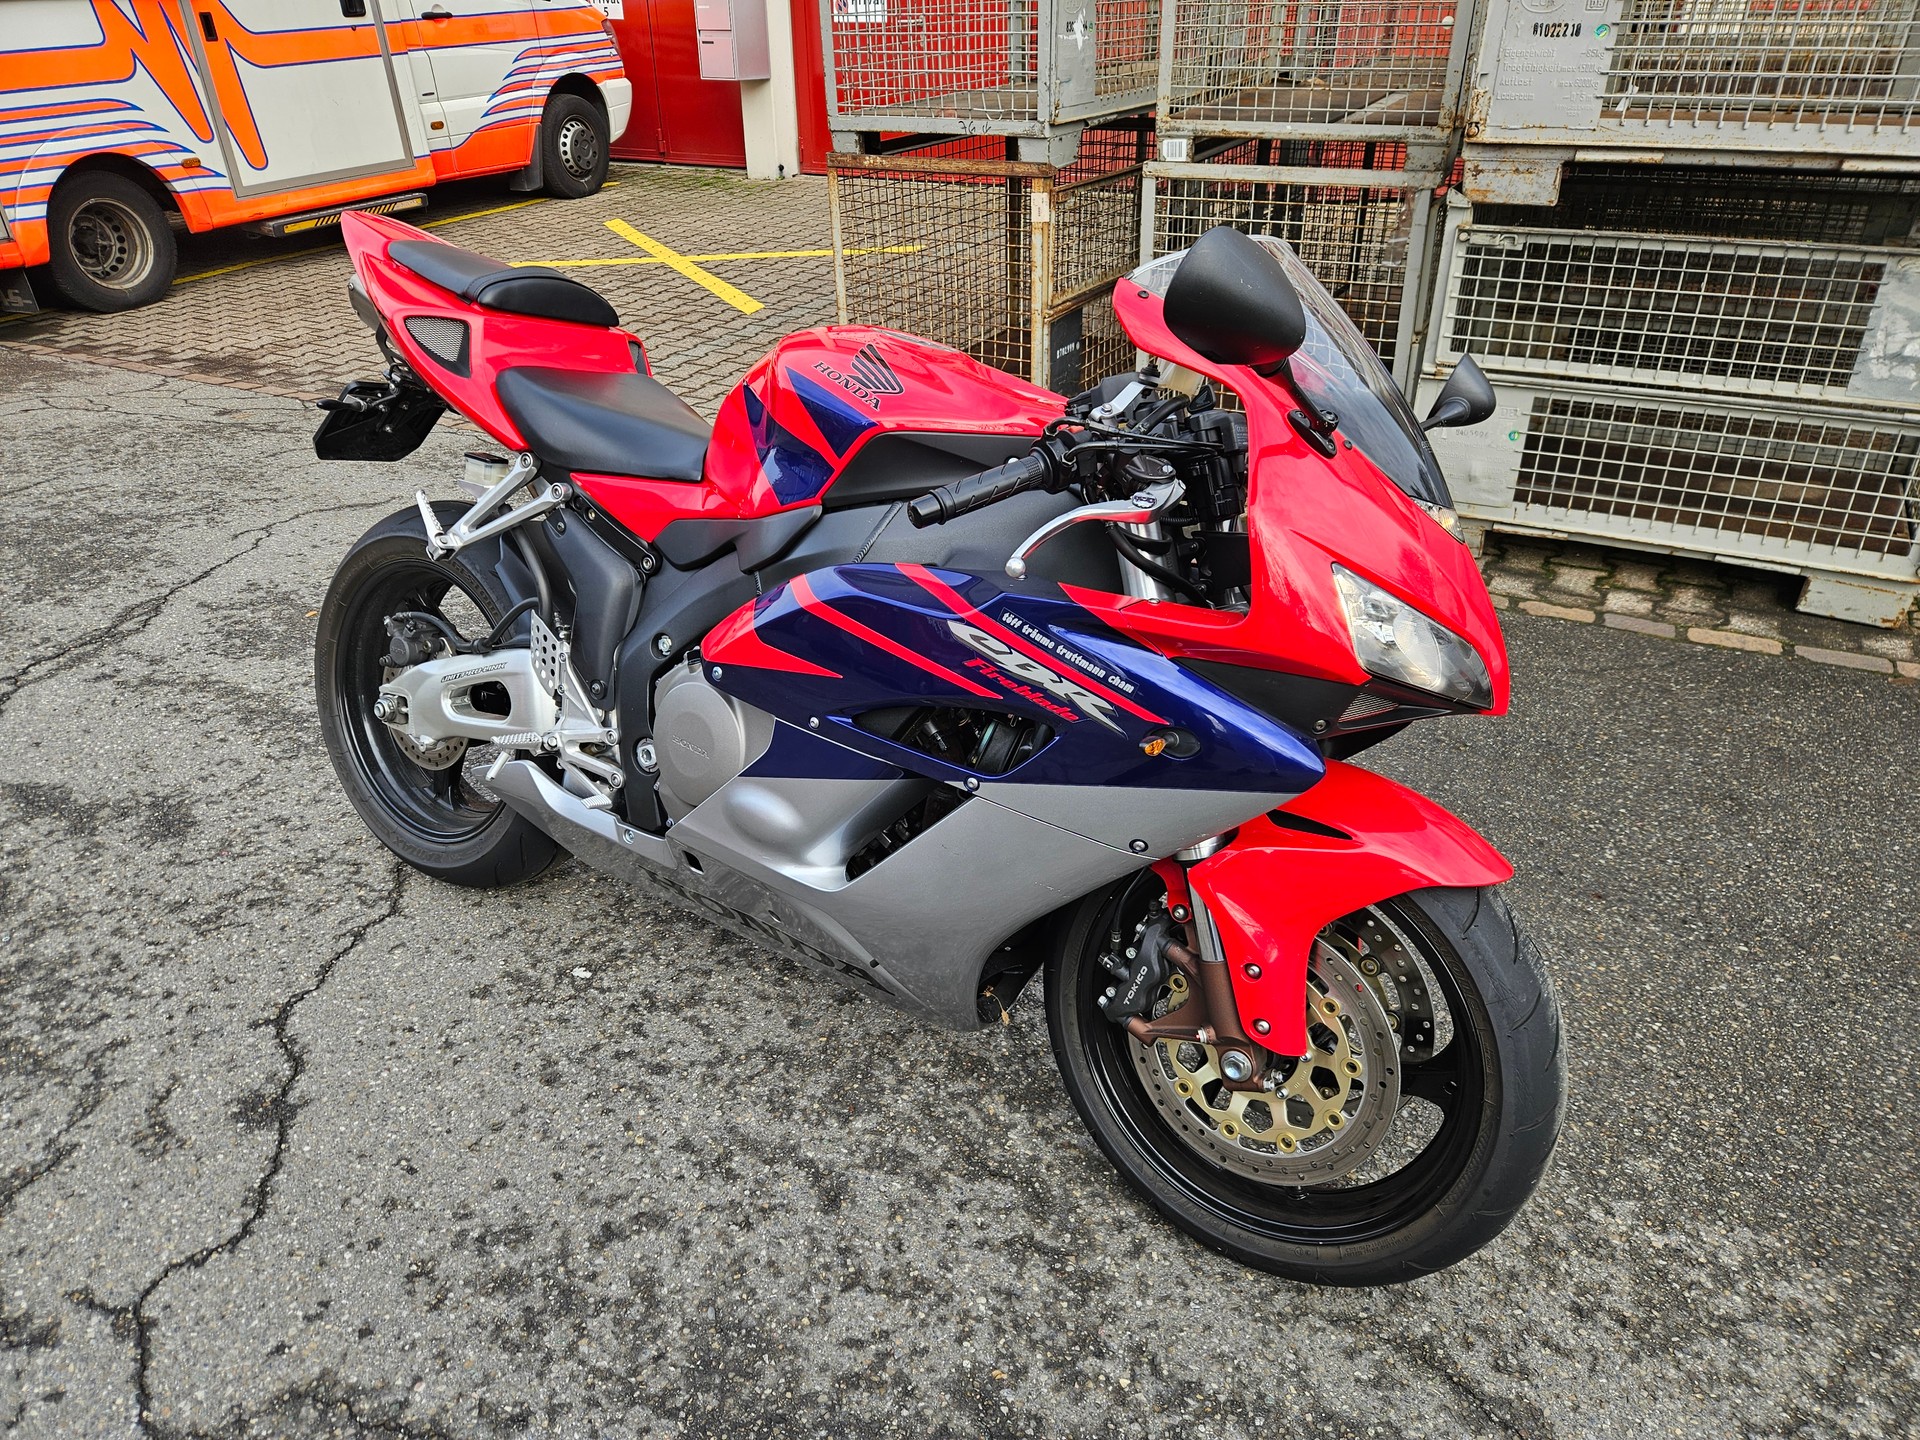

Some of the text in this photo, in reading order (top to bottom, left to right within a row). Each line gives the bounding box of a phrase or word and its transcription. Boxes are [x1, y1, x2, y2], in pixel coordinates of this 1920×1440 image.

[604, 7, 609, 17] 5
[813, 360, 881, 411] HONDA
[946, 619, 1128, 739] CBR
[1002, 612, 1135, 695] töff träume truttmann cham
[964, 657, 1079, 722] Fireblade
[672, 734, 710, 760] HONDA
[1123, 965, 1148, 1005] TOKICO
